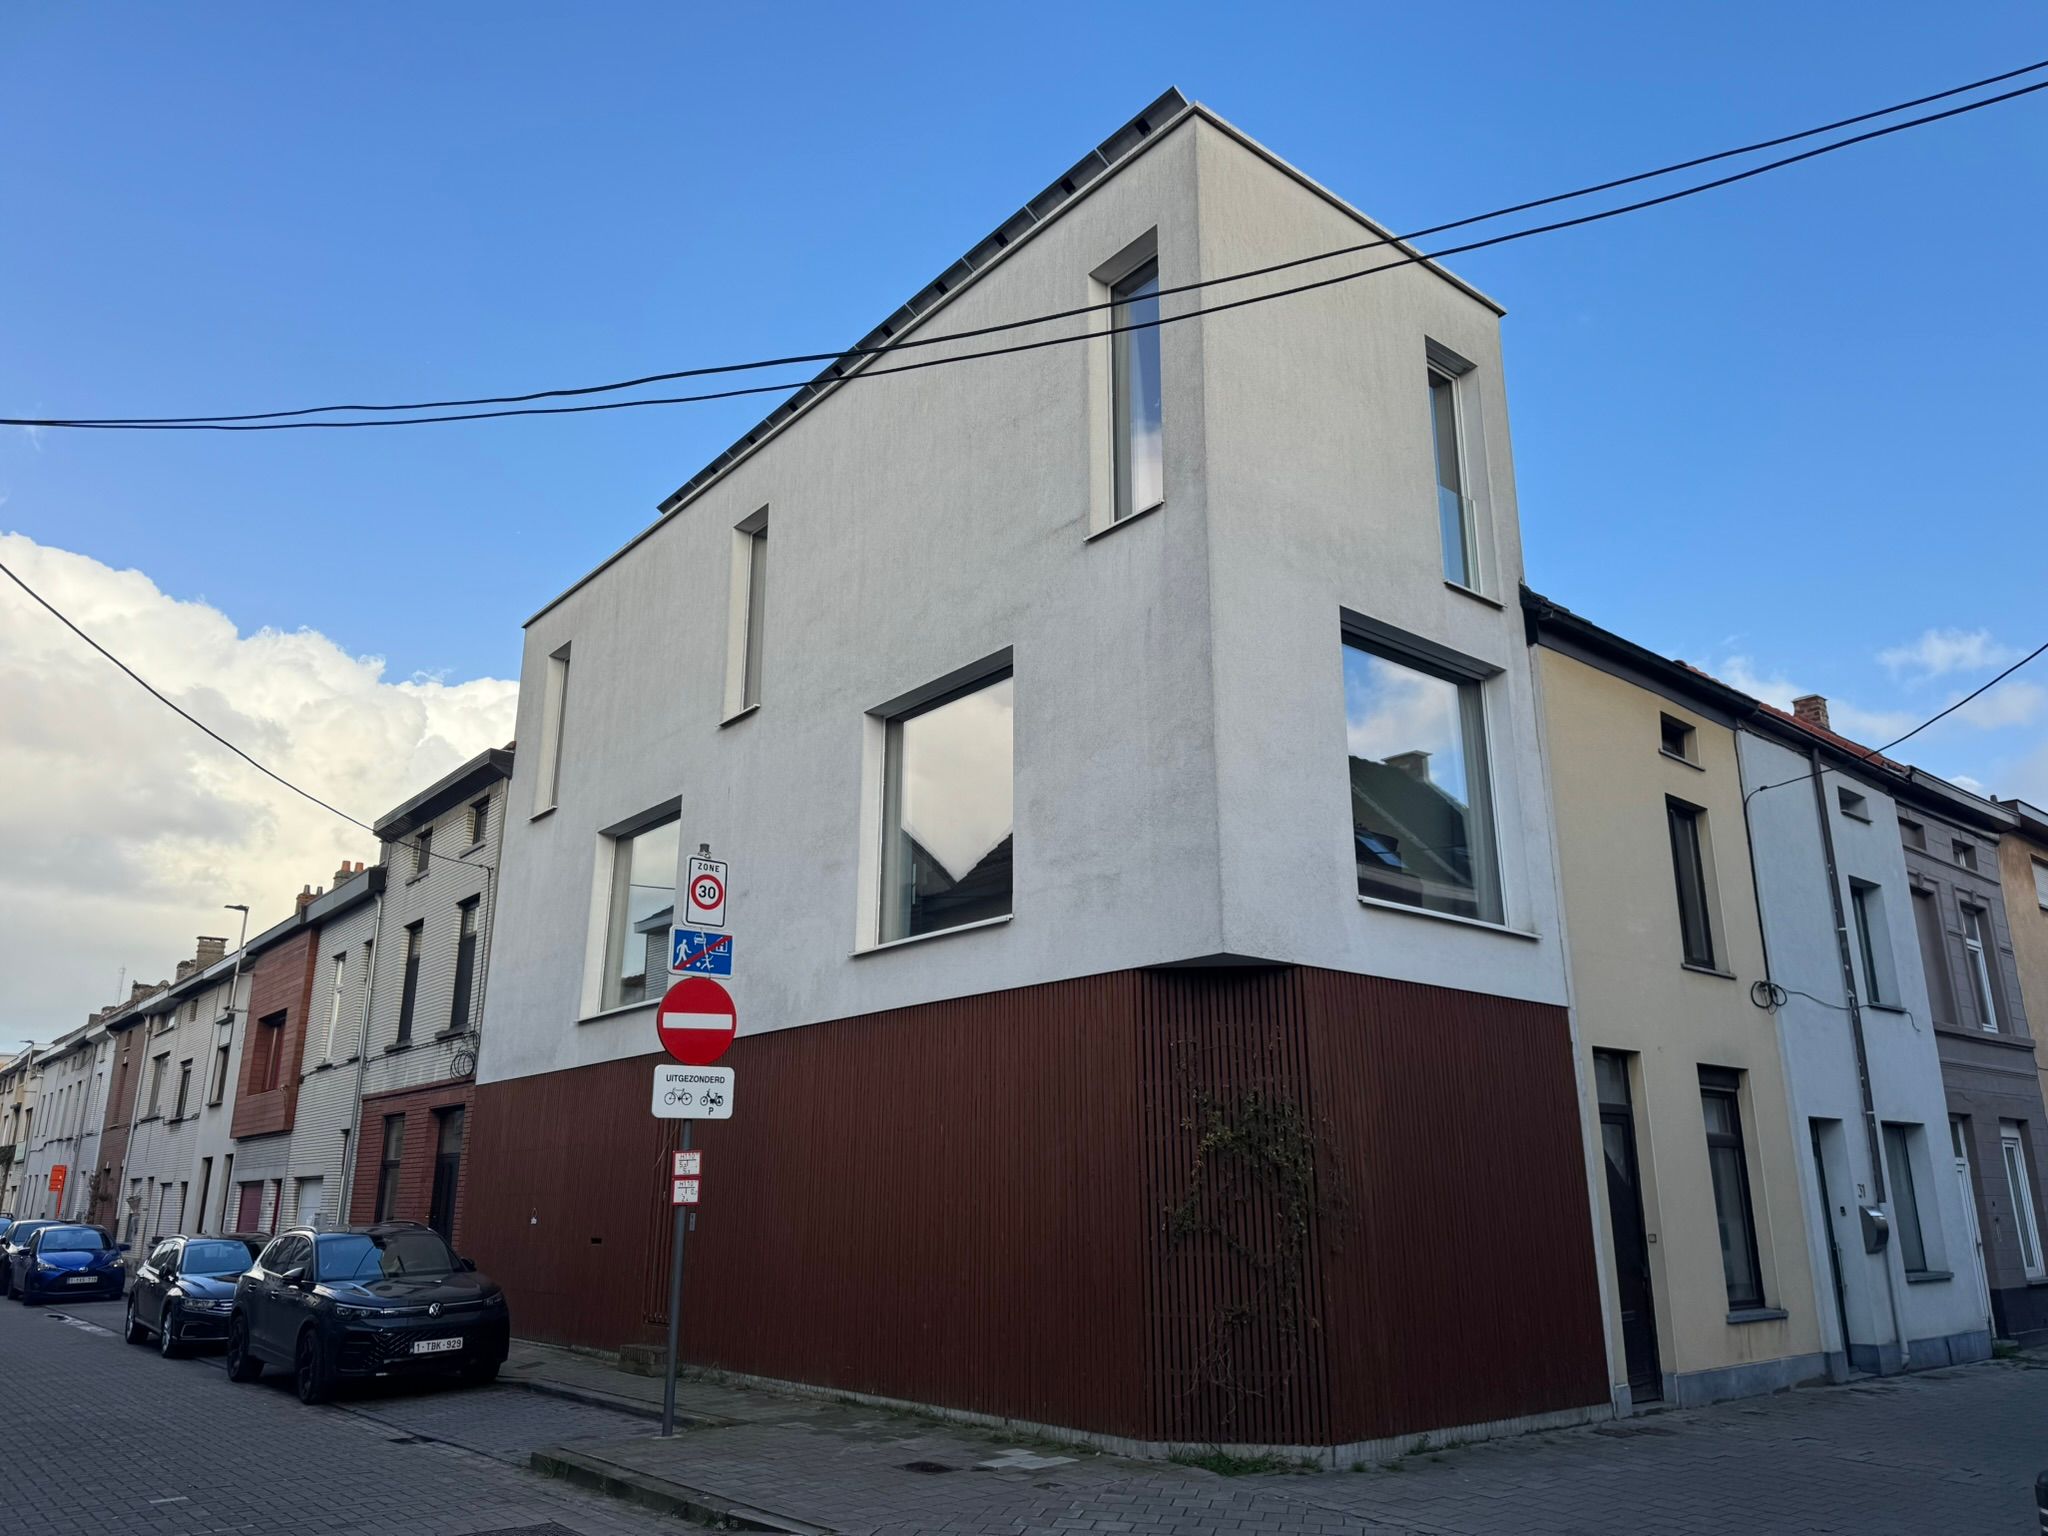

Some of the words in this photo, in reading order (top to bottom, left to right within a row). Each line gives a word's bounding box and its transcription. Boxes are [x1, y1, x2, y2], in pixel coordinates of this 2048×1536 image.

[697, 862, 720, 873] ZONE
[698, 885, 717, 899] 30
[666, 1074, 726, 1084] UITGEZONDERD
[708, 1106, 714, 1116] P
[415, 1339, 462, 1353] 1-TBK-929
